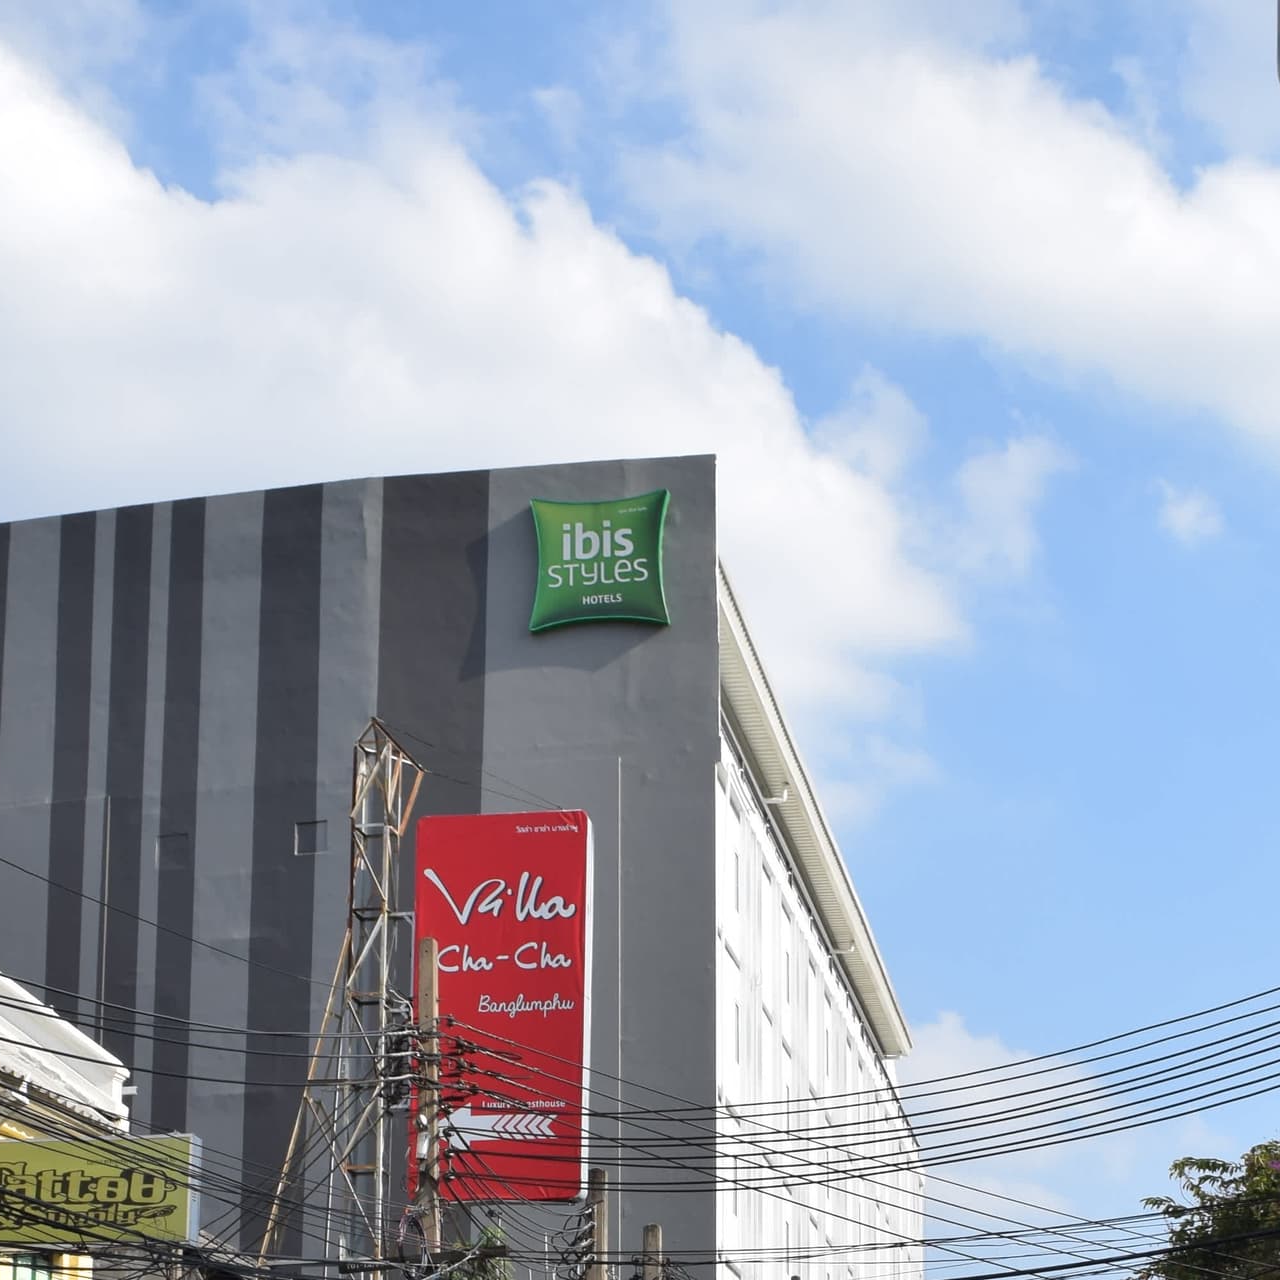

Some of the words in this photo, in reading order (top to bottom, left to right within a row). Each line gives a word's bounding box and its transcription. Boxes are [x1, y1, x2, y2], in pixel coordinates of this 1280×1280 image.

[562, 520, 634, 561] ibis
[582, 593, 623, 606] HOTELS
[478, 993, 575, 1018] Banglumphu
